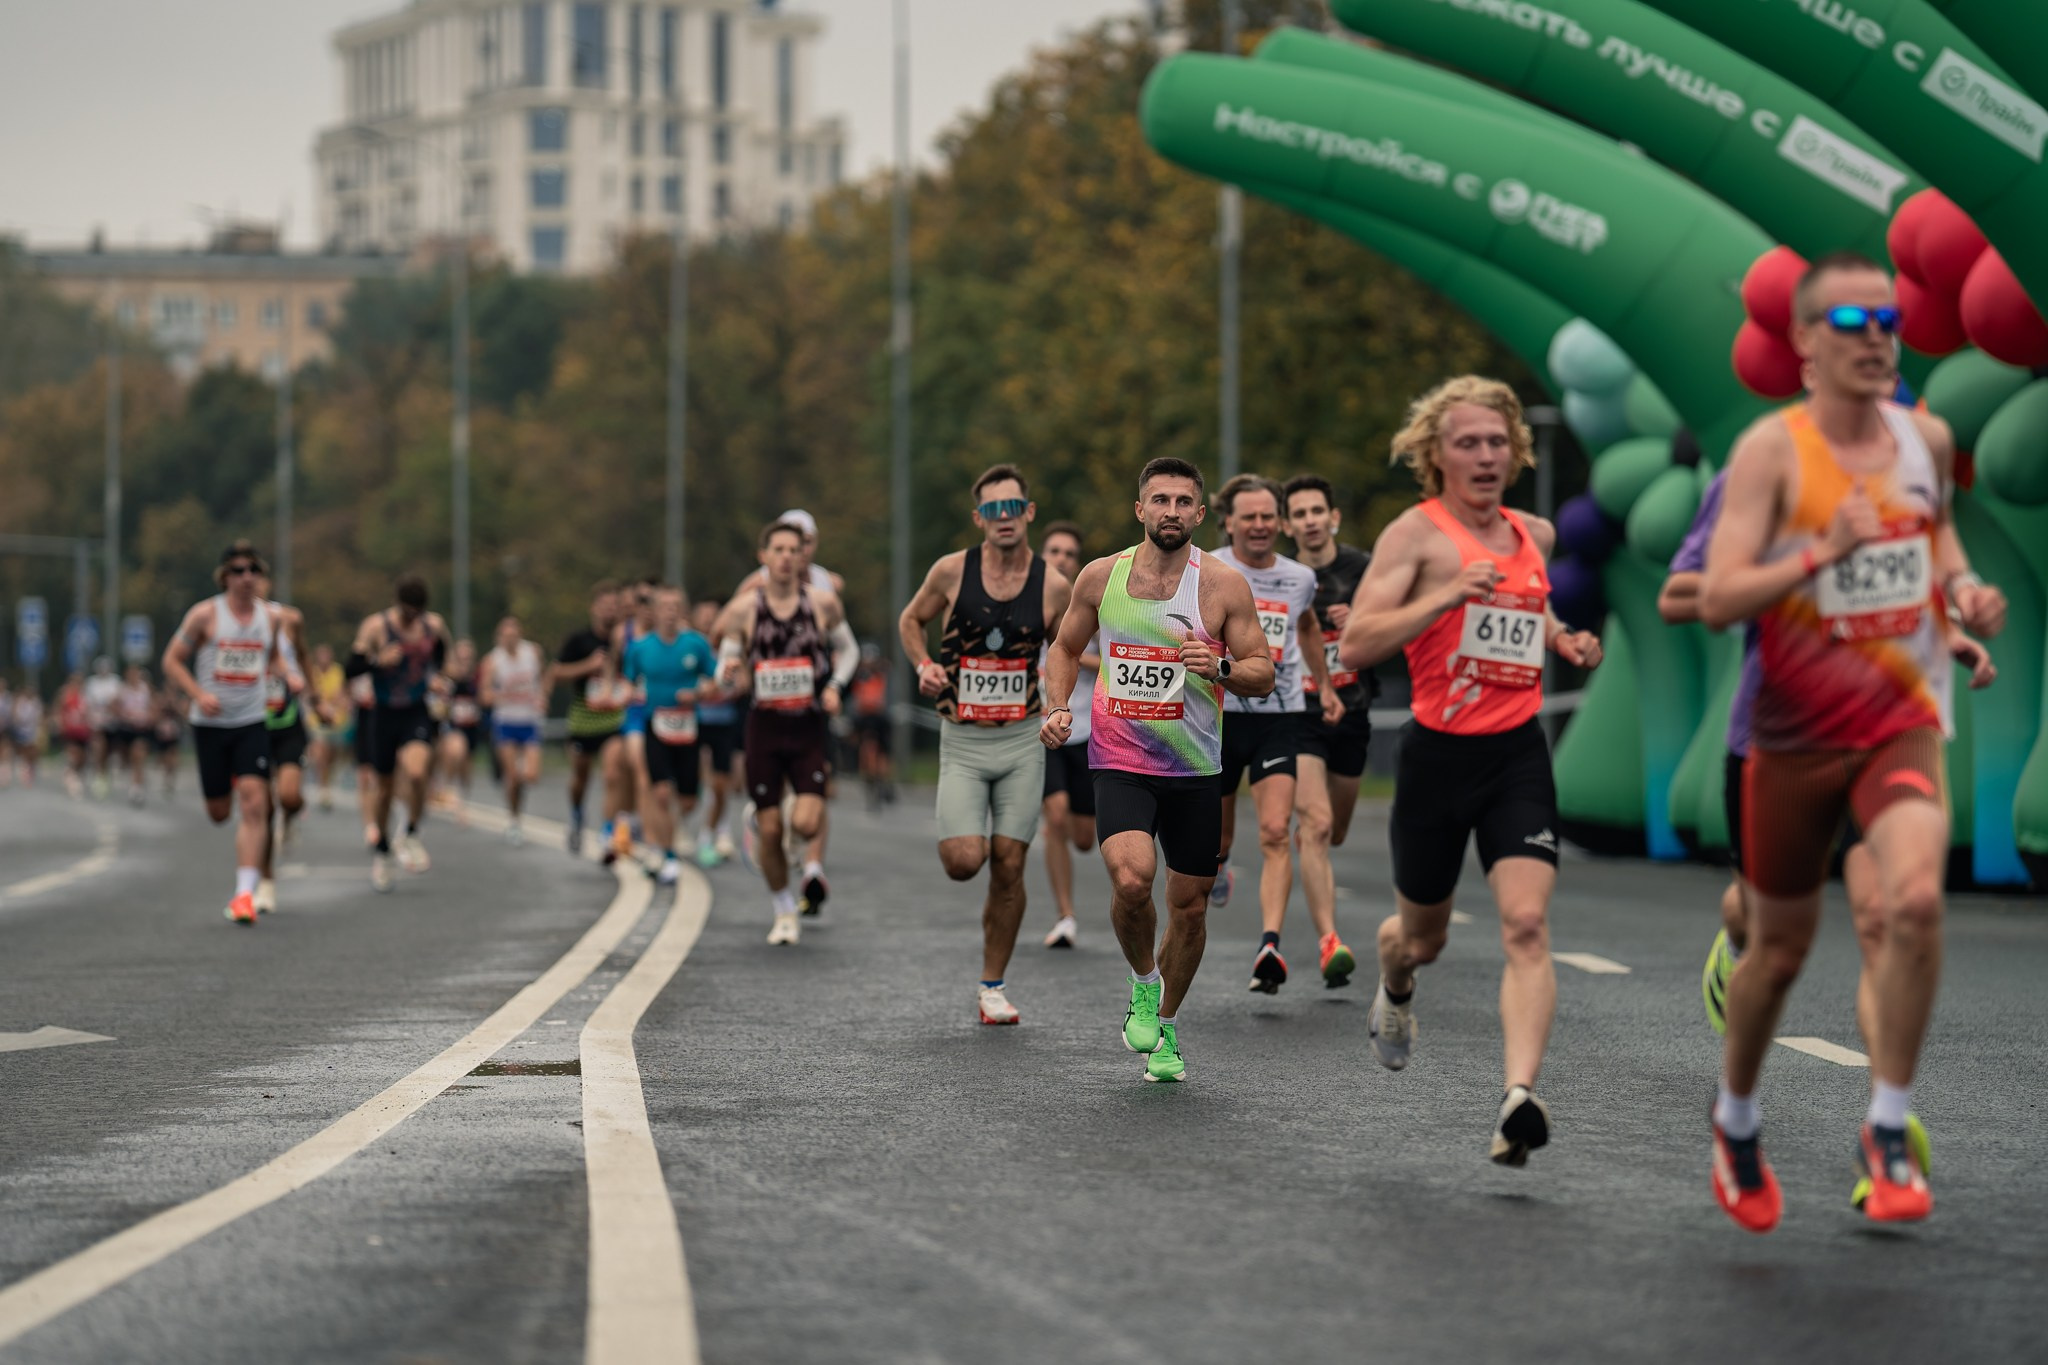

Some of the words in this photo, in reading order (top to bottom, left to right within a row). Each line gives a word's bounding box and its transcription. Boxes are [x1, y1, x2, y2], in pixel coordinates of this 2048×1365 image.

[1892, 40, 1926, 72] с
[1598, 35, 1746, 120] лучше
[1750, 107, 1782, 138] с
[1214, 101, 1448, 187] Настройся
[1453, 172, 1483, 200] с
[1258, 615, 1285, 635] 25
[1476, 612, 1537, 648] 6167
[963, 673, 1023, 693] 19910
[1117, 663, 1175, 688] 3459
[1128, 689, 1160, 698] КИРИЛЛ
